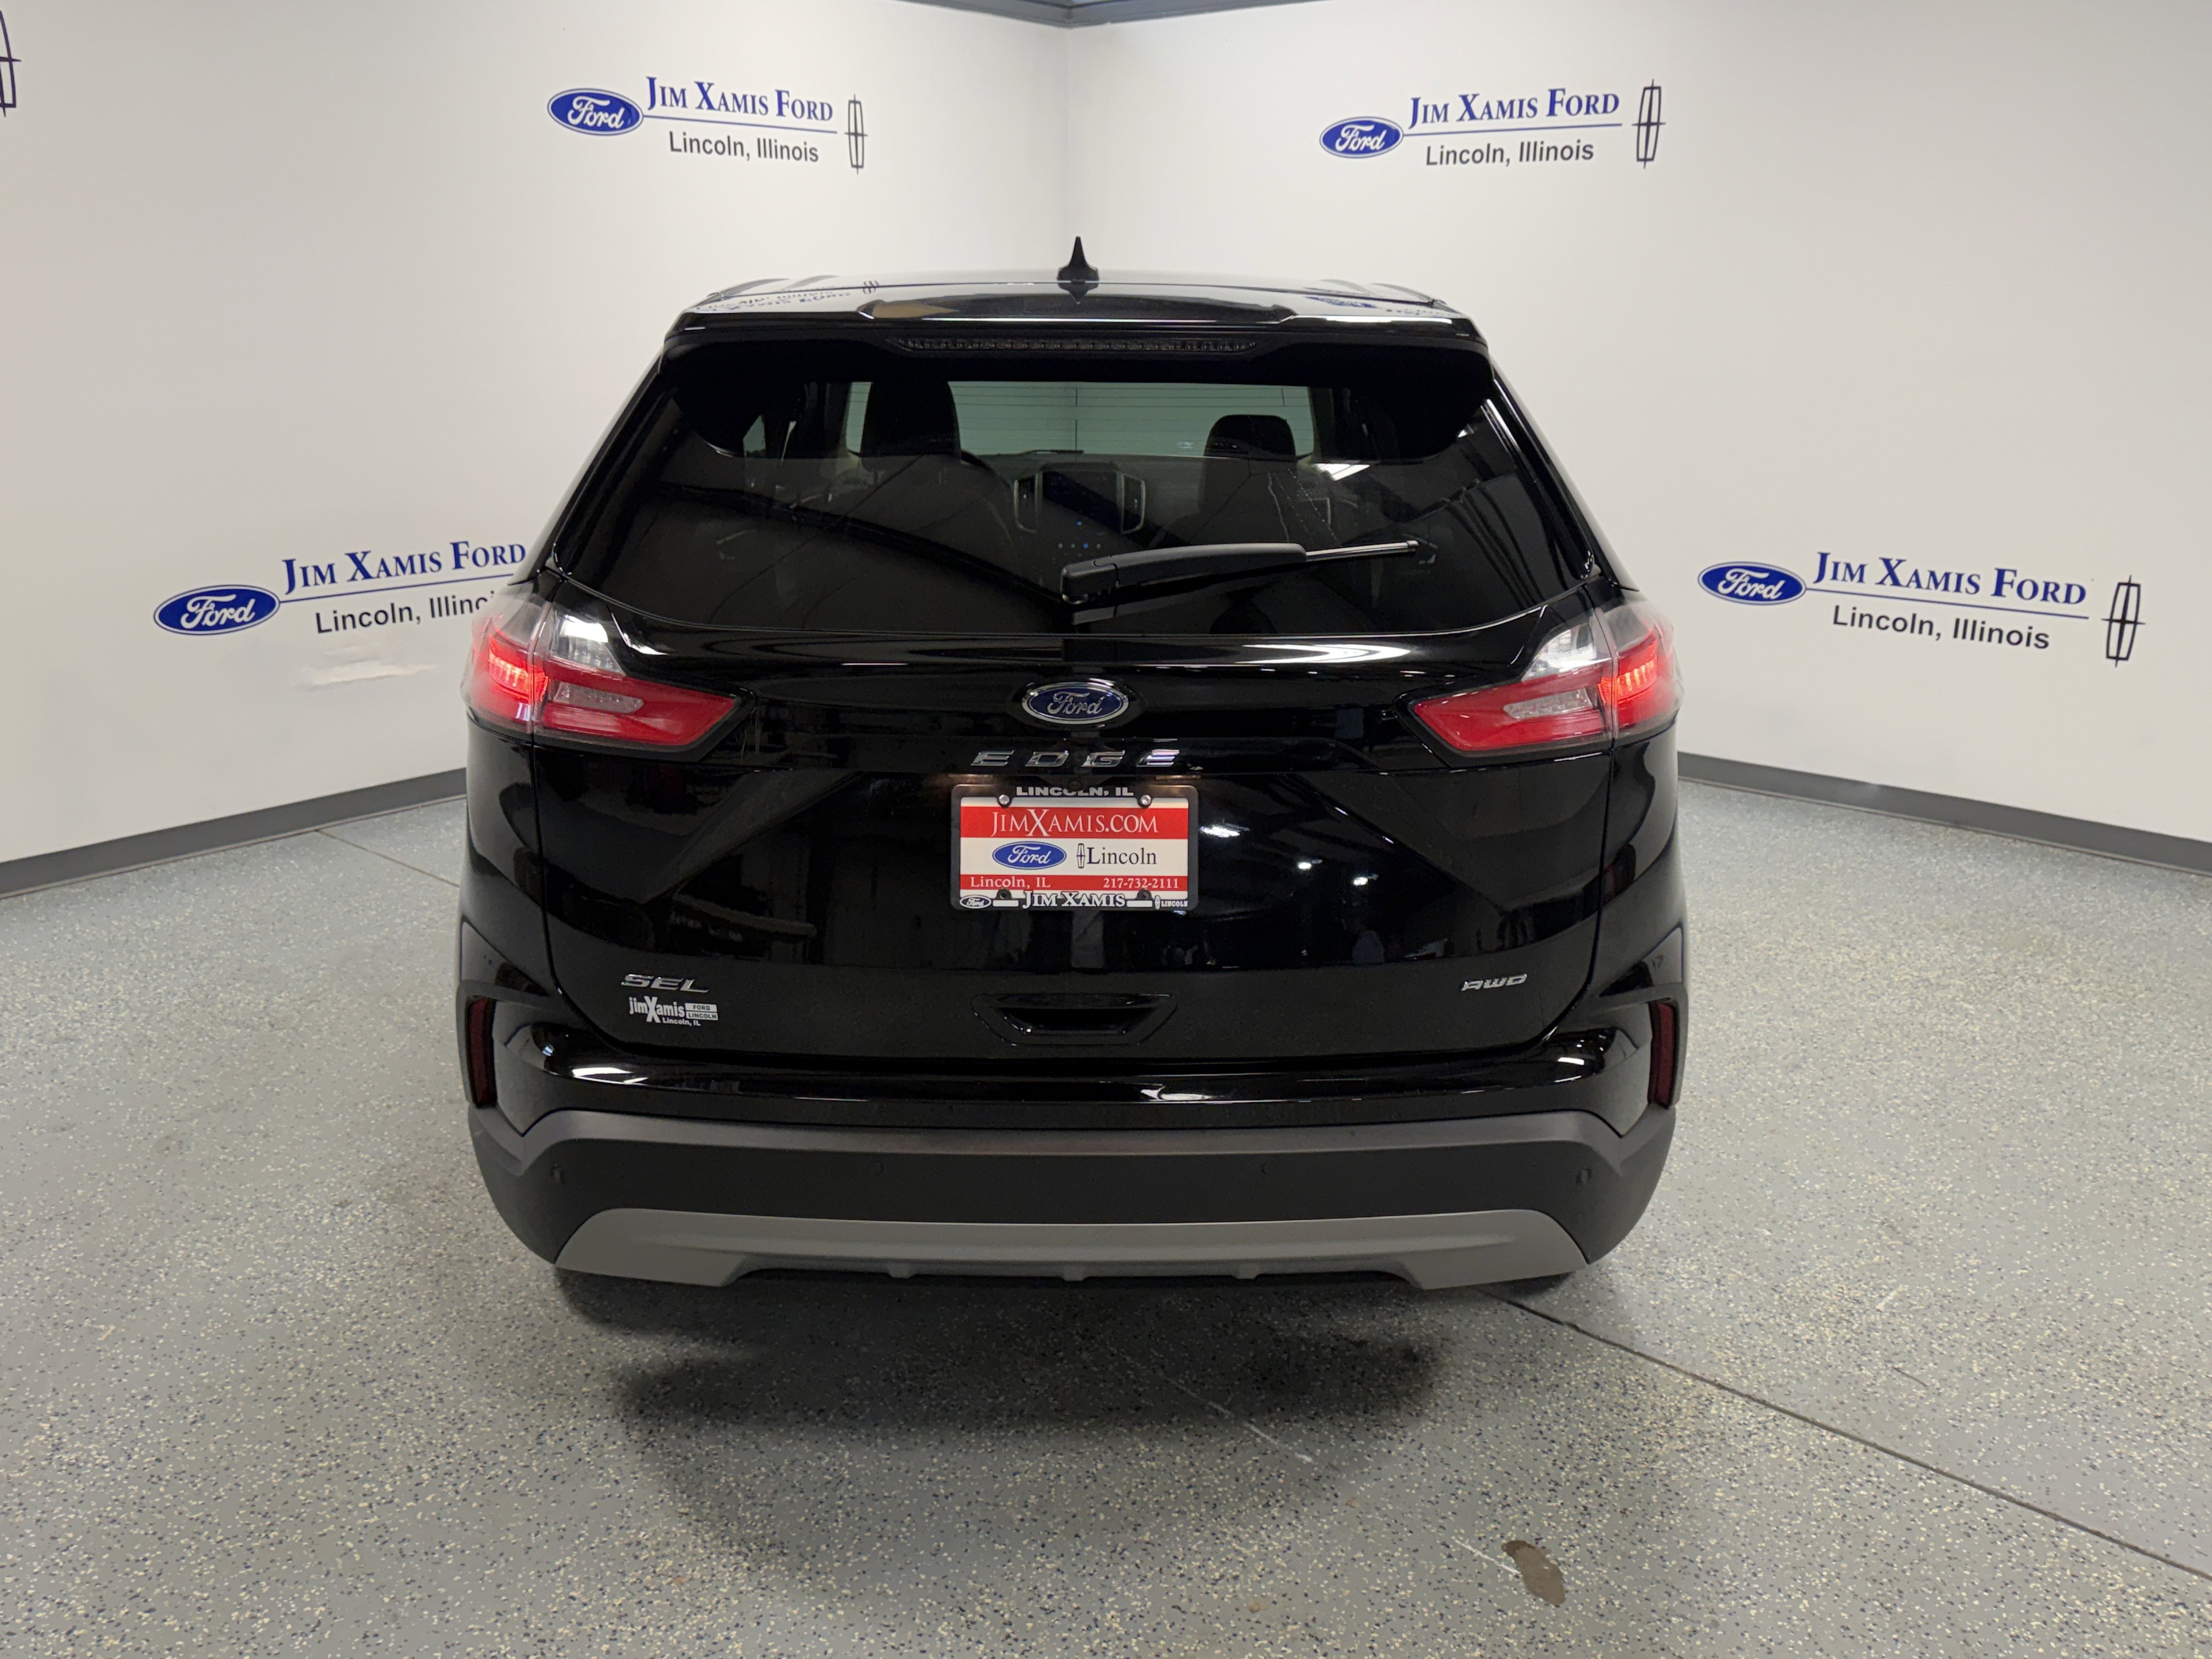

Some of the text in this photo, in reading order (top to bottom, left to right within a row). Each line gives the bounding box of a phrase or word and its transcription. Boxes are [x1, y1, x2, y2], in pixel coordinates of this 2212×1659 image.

[567, 95, 625, 129] Ford
[646, 76, 833, 122] JIM XAMIS FORD
[1408, 87, 1620, 129] JIM XAMIS FORD
[669, 131, 819, 163] Lincoln, Illinois
[1335, 123, 1386, 152] Ford
[1426, 139, 1594, 167] Lincoln, Illinois
[281, 541, 527, 595] JIM XAMIS FORD
[1813, 551, 2086, 605] JIM XAMIS FORD
[1718, 567, 1785, 601] Ford
[180, 594, 256, 630] Ford
[315, 602, 421, 634] Lincoln,
[1832, 605, 2050, 650] Lincoln, Illinois
[1047, 691, 1105, 715] Ford
[970, 749, 1180, 768] EDGE
[1115, 787, 1134, 796] IL
[1007, 845, 1158, 865] Ford Lincoln
[970, 876, 1051, 889] Lincoln, IL
[1103, 878, 1179, 889] 217-732-2111
[966, 898, 985, 907] Ford
[1022, 890, 1125, 909] JIM XAMIS
[621, 974, 710, 994] SEL
[1461, 974, 1528, 991] AWD
[662, 1017, 692, 1026] Lincoln,
